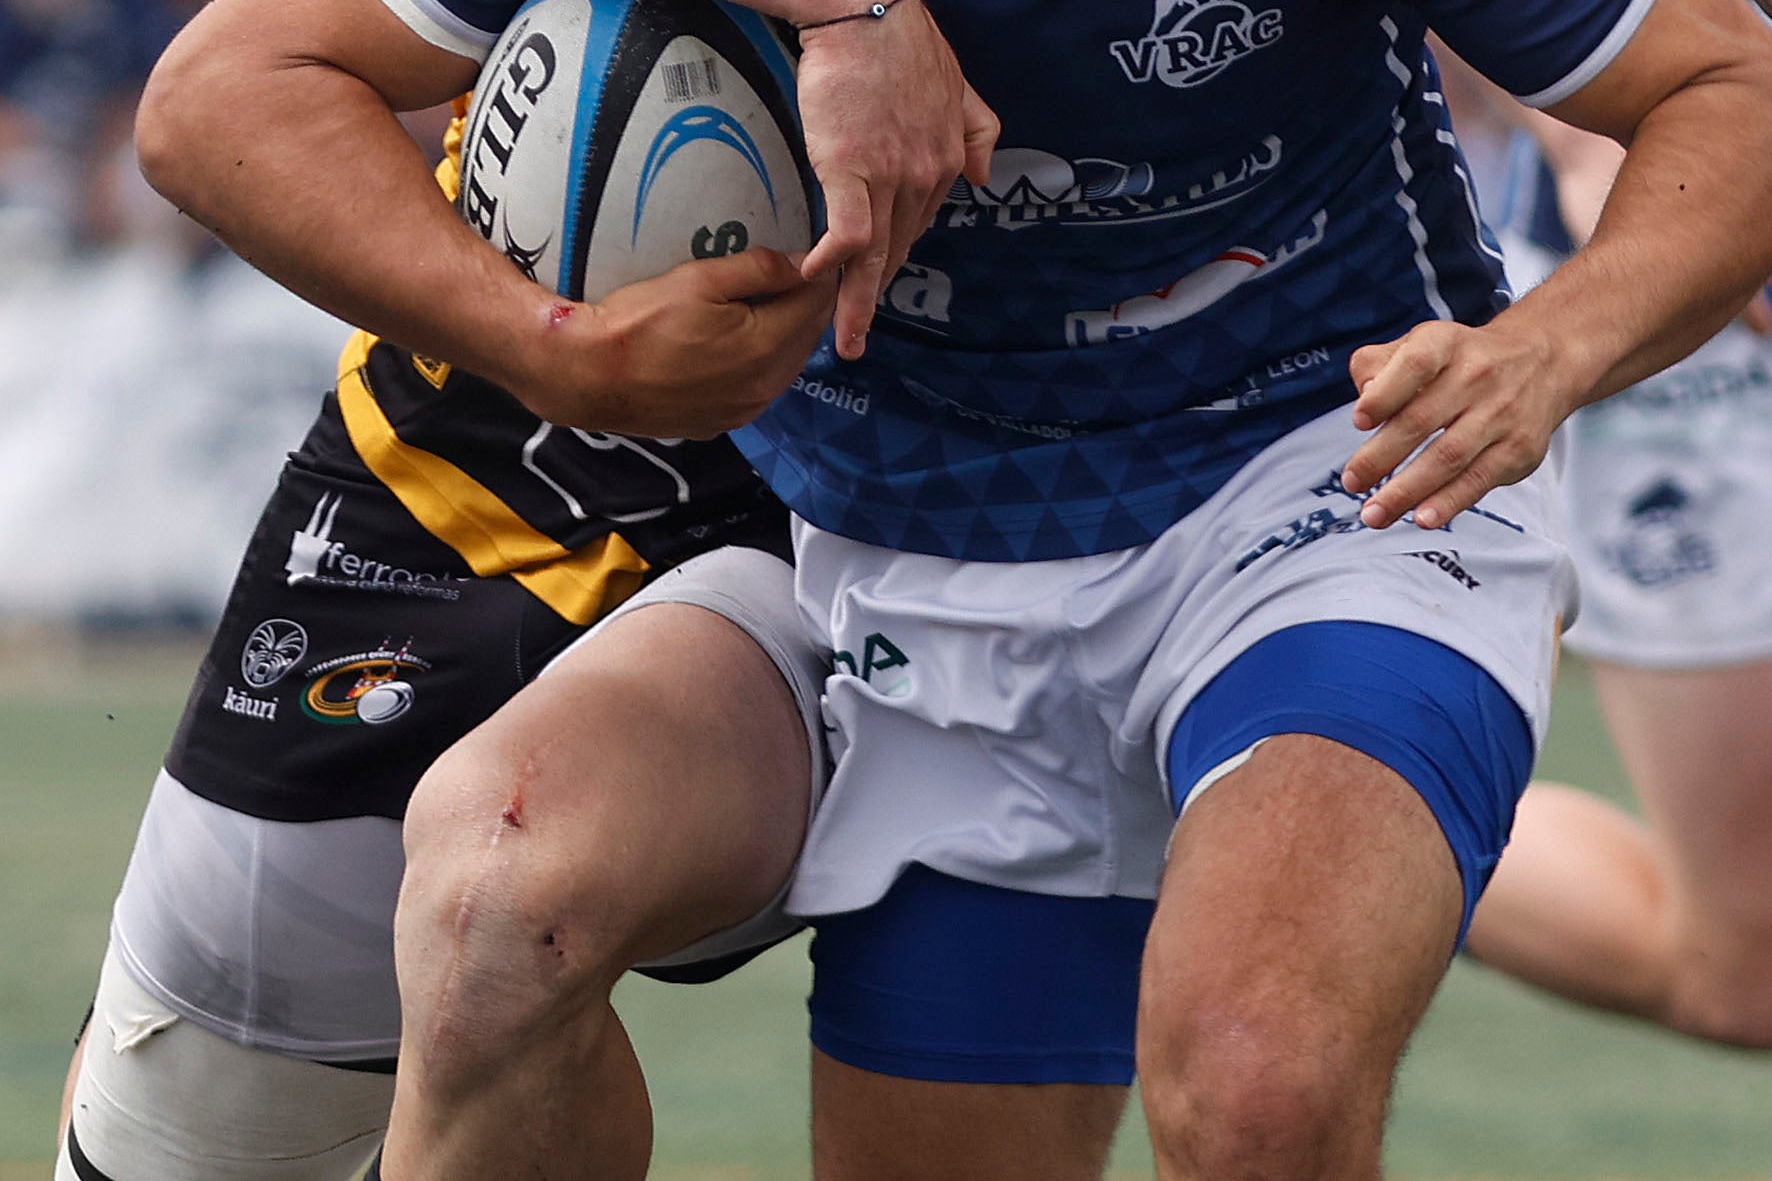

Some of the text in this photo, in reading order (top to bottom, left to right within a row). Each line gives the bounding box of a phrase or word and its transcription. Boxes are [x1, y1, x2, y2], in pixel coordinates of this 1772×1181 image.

[1110, 8, 1285, 83] VRAC
[467, 32, 557, 242] GILB
[789, 376, 871, 416] adolid
